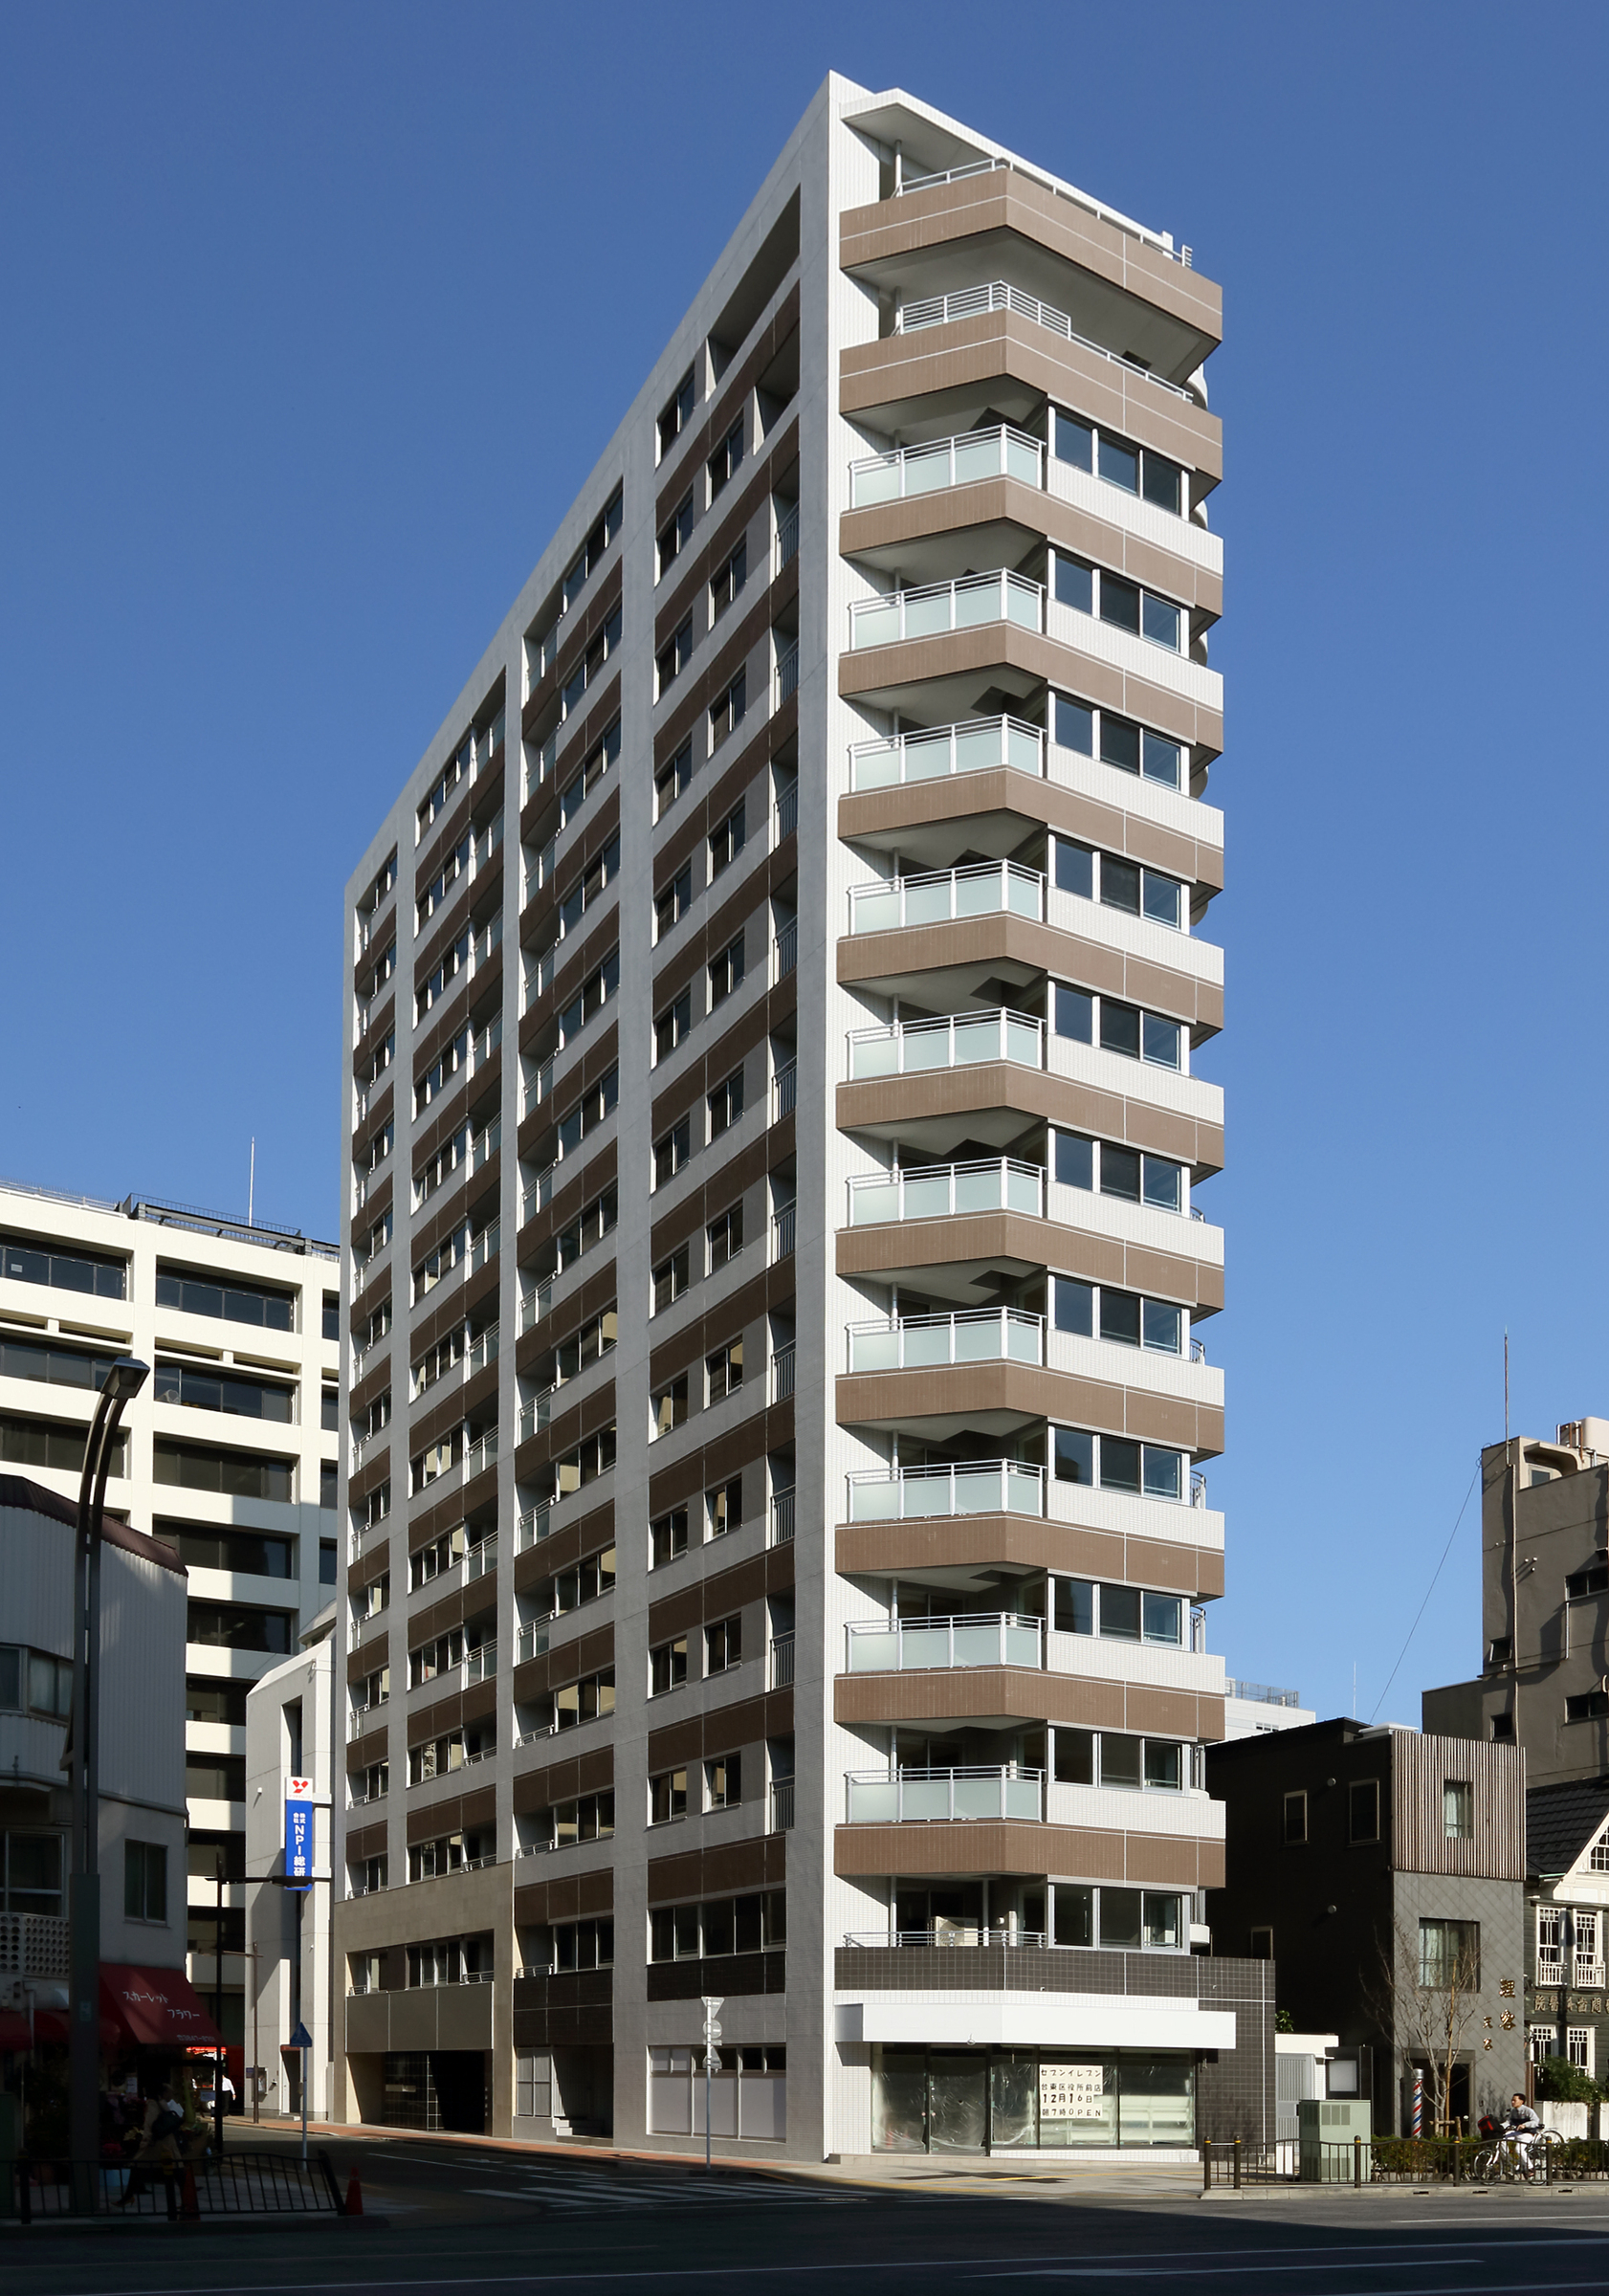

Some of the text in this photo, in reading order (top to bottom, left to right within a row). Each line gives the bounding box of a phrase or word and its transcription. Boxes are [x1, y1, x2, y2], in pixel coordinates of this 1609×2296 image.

[122, 1991, 168, 2003] スカーレット
[166, 2009, 200, 2020] フラワー
